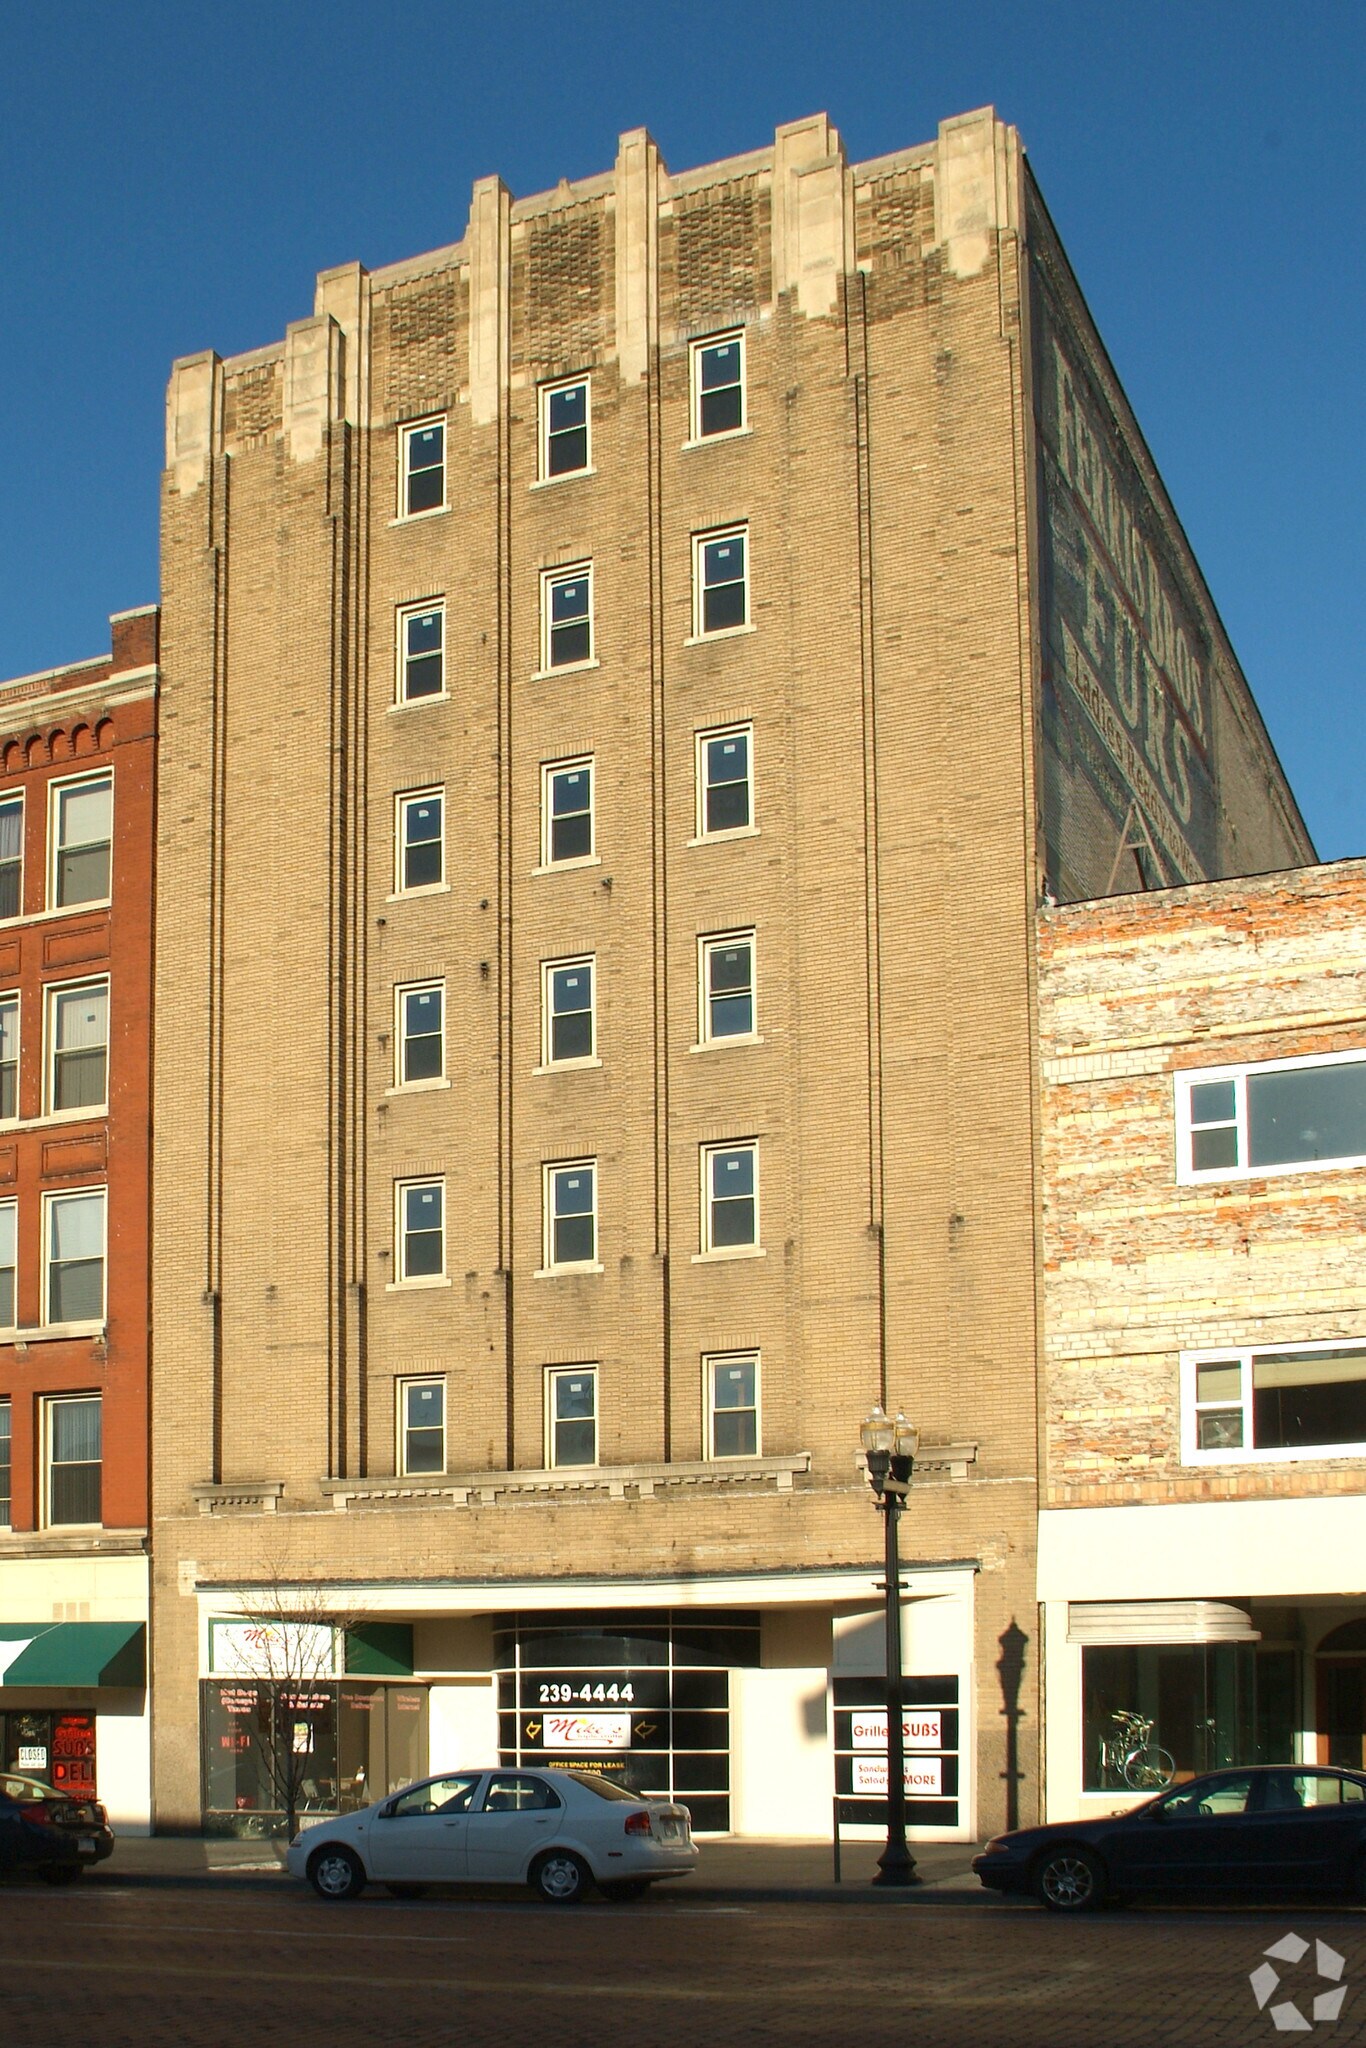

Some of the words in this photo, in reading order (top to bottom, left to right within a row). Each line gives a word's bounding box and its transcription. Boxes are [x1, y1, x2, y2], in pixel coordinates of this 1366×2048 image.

[1080, 526, 1191, 826] FURS
[539, 1683, 634, 1702] 239-4444
[854, 1725, 889, 1736] Grille
[903, 1724, 939, 1736] SUBS
[20, 1748, 46, 1760] CLOSED
[55, 1764, 94, 1780] DELI
[903, 1775, 936, 1785] MORE
